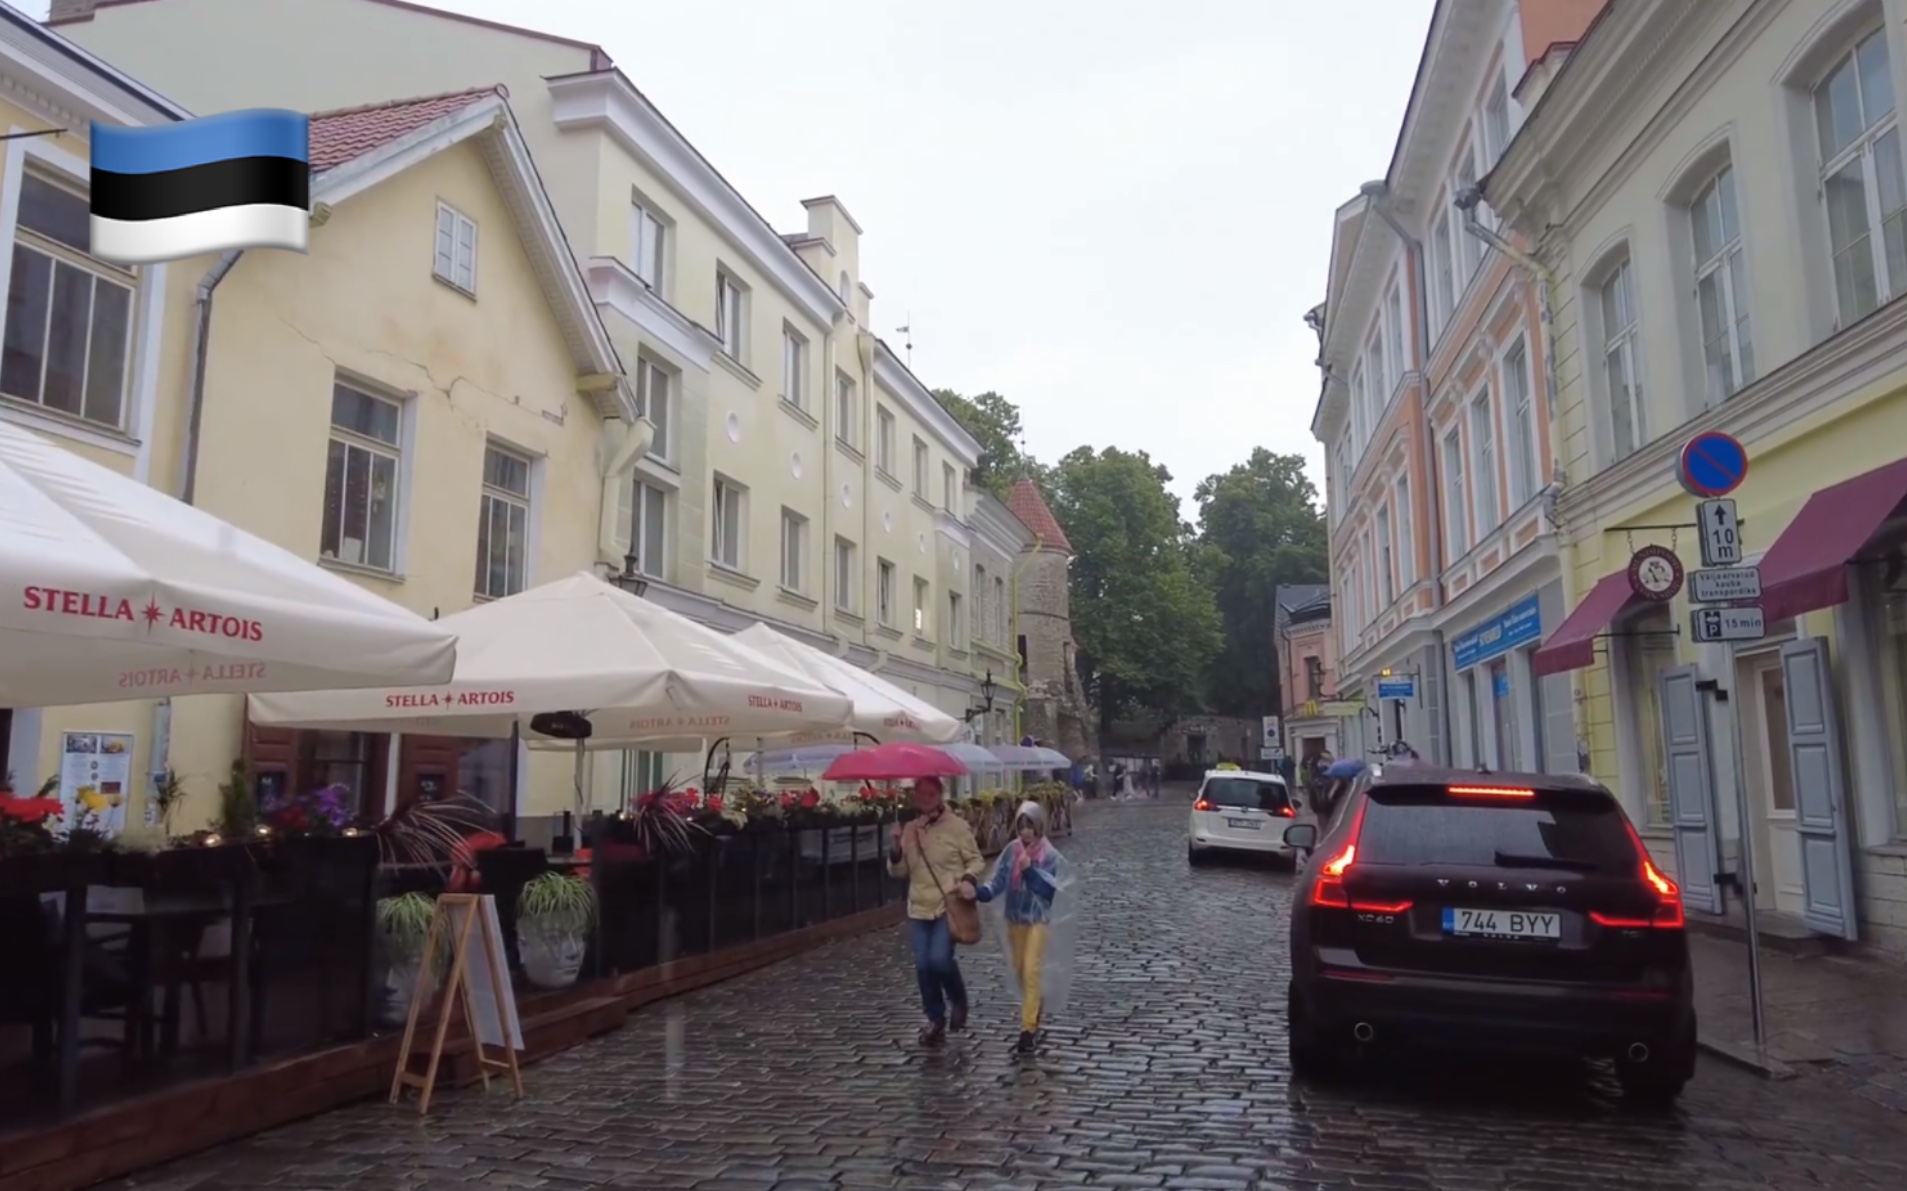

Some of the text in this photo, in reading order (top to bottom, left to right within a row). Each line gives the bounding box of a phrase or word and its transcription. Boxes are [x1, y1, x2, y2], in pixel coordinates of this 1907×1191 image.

[1712, 528, 1734, 544] 10
[1718, 546, 1733, 558] m
[23, 586, 263, 641] STELLA ARTOIS
[1724, 618, 1762, 629] 15 min
[385, 691, 515, 708] STELLA ARTOIS
[748, 695, 803, 713] STELLA ARTOIS
[1437, 879, 1566, 894] VOLVO
[1462, 911, 1553, 934] 744 BYY
